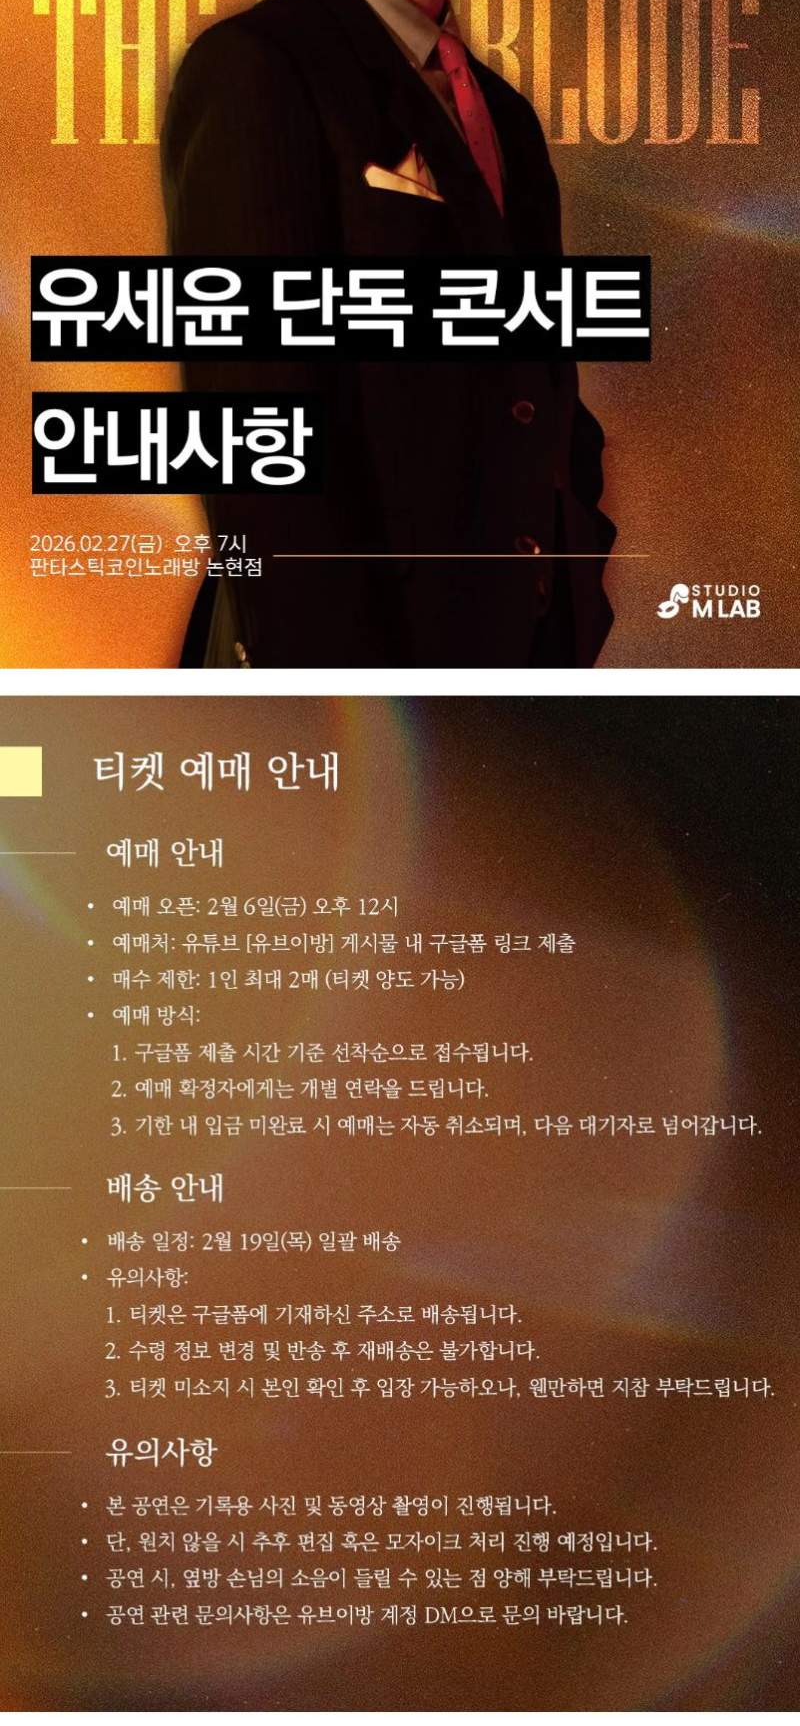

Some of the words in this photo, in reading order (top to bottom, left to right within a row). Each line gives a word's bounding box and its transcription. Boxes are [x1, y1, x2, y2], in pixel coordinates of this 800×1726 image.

[32, 267, 249, 347] 유세윤
[273, 268, 413, 347] 단독
[432, 267, 650, 347] 콘서트
[34, 407, 313, 486] 안내사항
[30, 534, 162, 554] 2026.02.27(금)
[174, 533, 212, 554] 오후
[217, 534, 247, 554] 7시
[30, 557, 201, 577] 판타스틱코인노래방
[205, 556, 263, 578] 논현점
[691, 584, 760, 597] STUDIO
[93, 751, 165, 792] 티켓
[179, 751, 251, 792] 예매
[267, 751, 339, 792] 안내
[106, 837, 159, 868] 예매
[170, 837, 223, 868] 안내
[112, 895, 150, 917] 예매
[156, 896, 201, 917] 오픈:
[207, 895, 239, 917] 2월
[243, 895, 307, 918] 6일(금)
[312, 896, 352, 917] 오후
[359, 895, 398, 918] 12시
[112, 1004, 150, 1027] 예매
[156, 1005, 201, 1027] 방식:
[106, 1172, 163, 1204] 배송
[170, 1172, 223, 1204] 안내
[106, 1266, 189, 1289] 유의사항:
[104, 1437, 219, 1468] 유의사항
[105, 1604, 145, 1626] 공연
[150, 1604, 189, 1626] 관련
[194, 1604, 292, 1626] 문의사항은
[296, 1604, 375, 1626] 유브이방
[380, 1604, 417, 1626] 계정
[424, 1605, 497, 1625] DM으로
[501, 1604, 540, 1626] 문의
[546, 1604, 629, 1626] 바랍니다.
